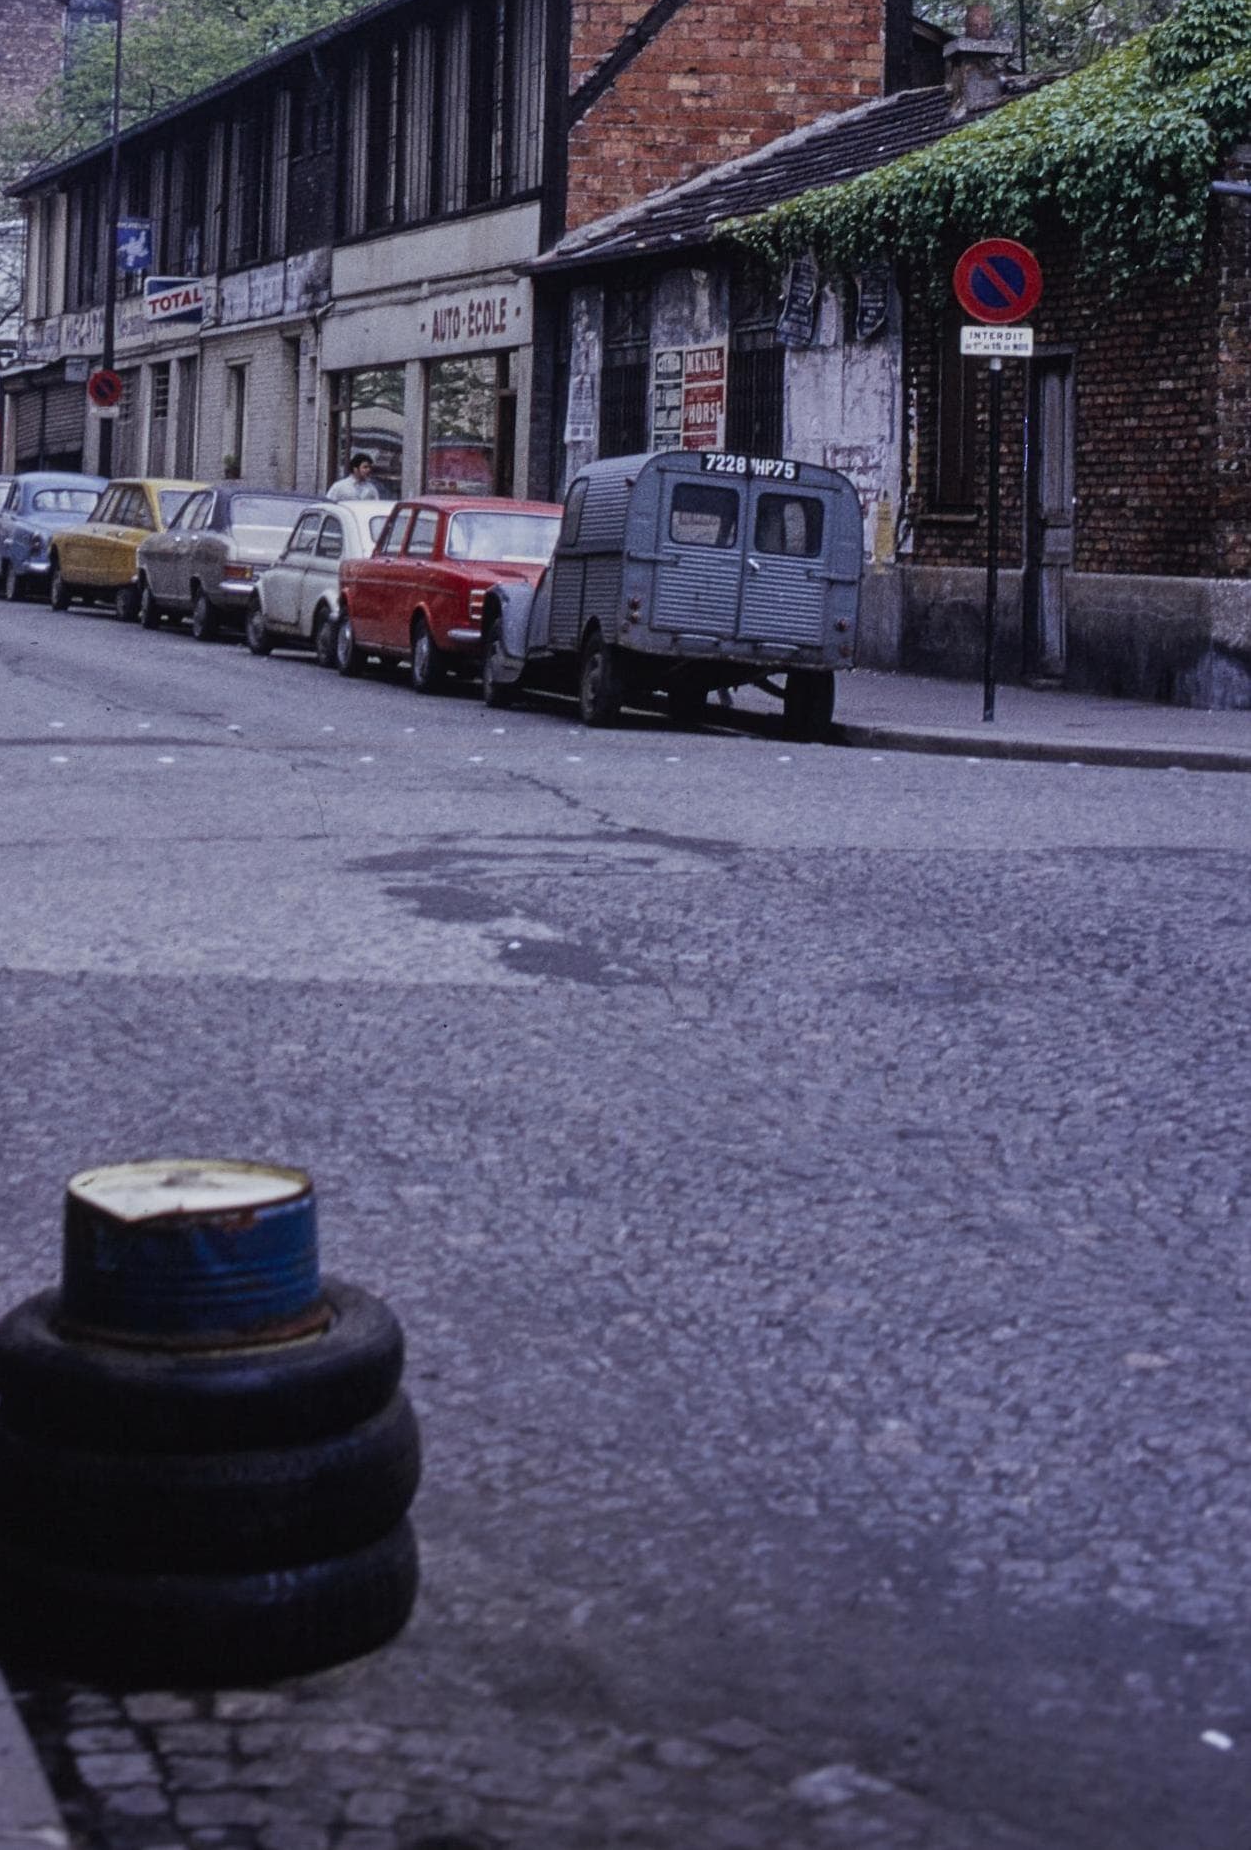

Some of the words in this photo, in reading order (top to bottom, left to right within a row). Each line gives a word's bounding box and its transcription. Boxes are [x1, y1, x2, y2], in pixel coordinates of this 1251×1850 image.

[148, 287, 203, 316] TOTAL
[969, 331, 1023, 341] INTERDIT
[706, 453, 747, 474] 7228
